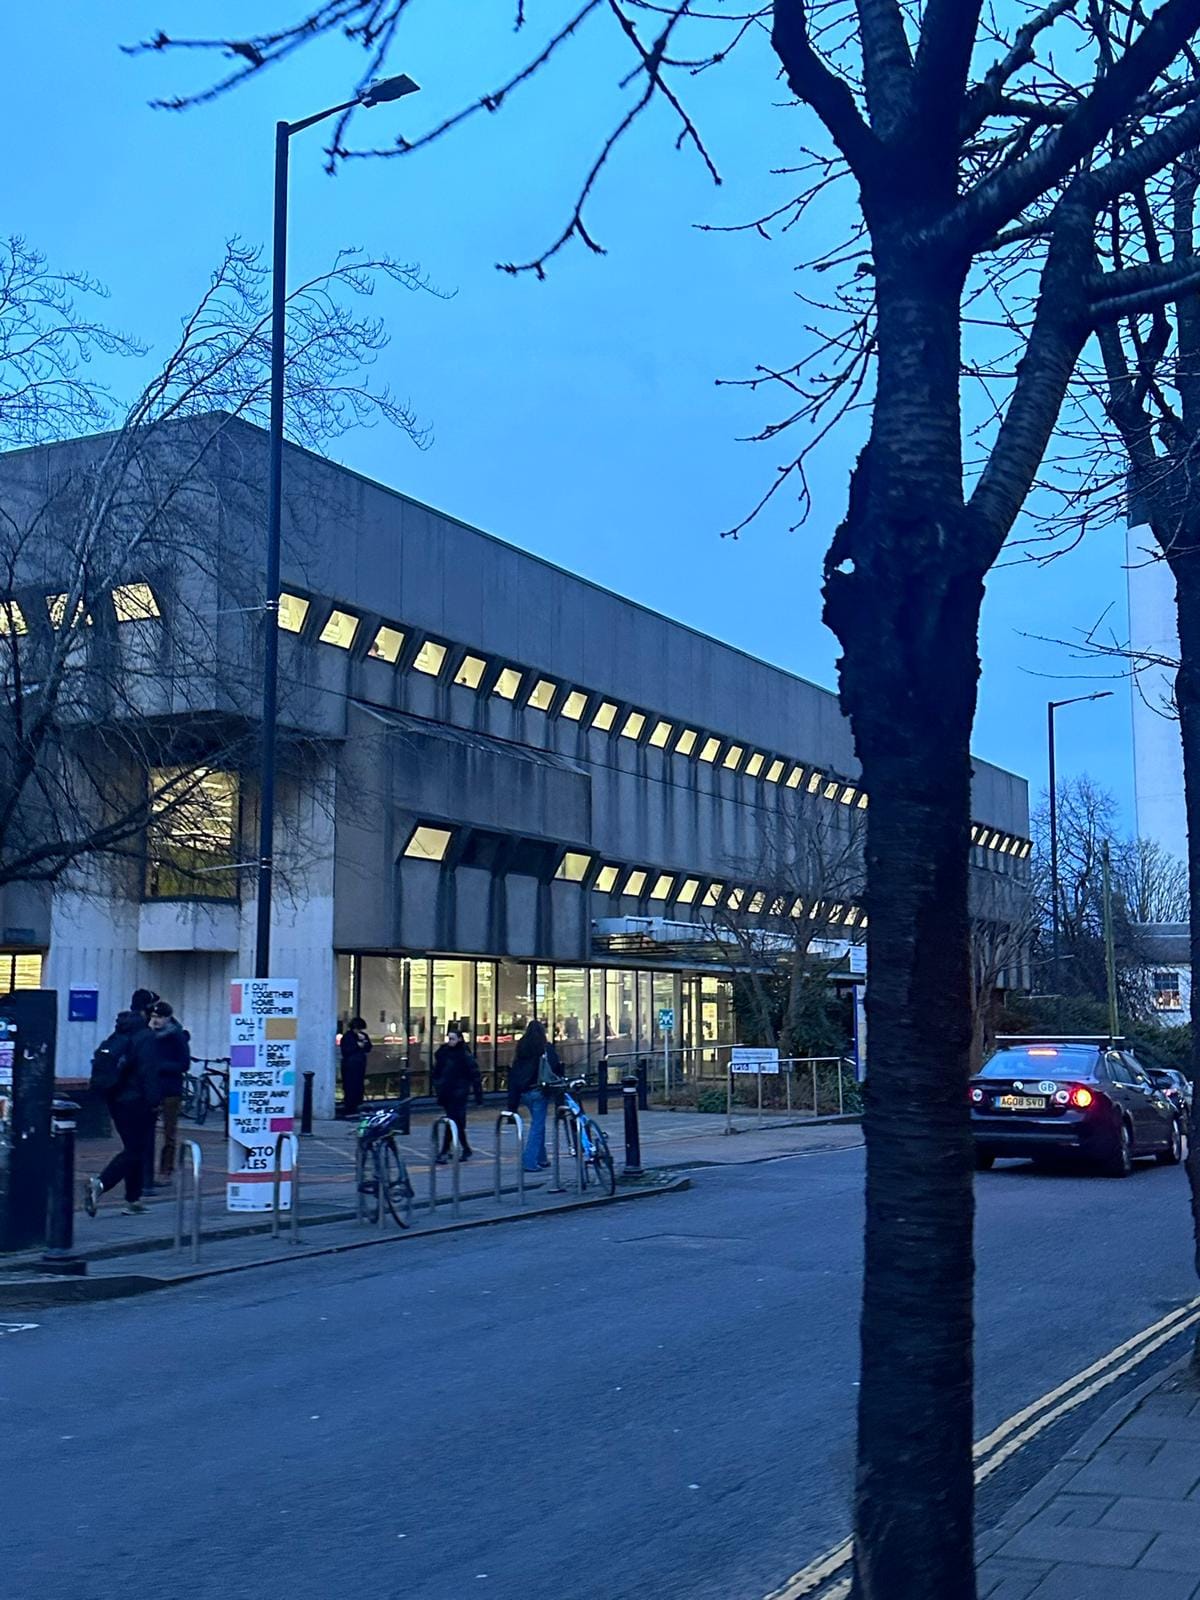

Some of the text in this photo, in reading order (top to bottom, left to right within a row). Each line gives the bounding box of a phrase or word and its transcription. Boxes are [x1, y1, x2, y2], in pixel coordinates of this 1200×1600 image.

[235, 1018, 255, 1026] CALL
[267, 1044, 290, 1052] DON'T
[266, 1060, 291, 1068] CREEP
[1040, 1083, 1054, 1092] GB
[264, 1106, 285, 1114] EDGE
[233, 1118, 252, 1126] TAKE
[241, 1126, 260, 1134] EASY
